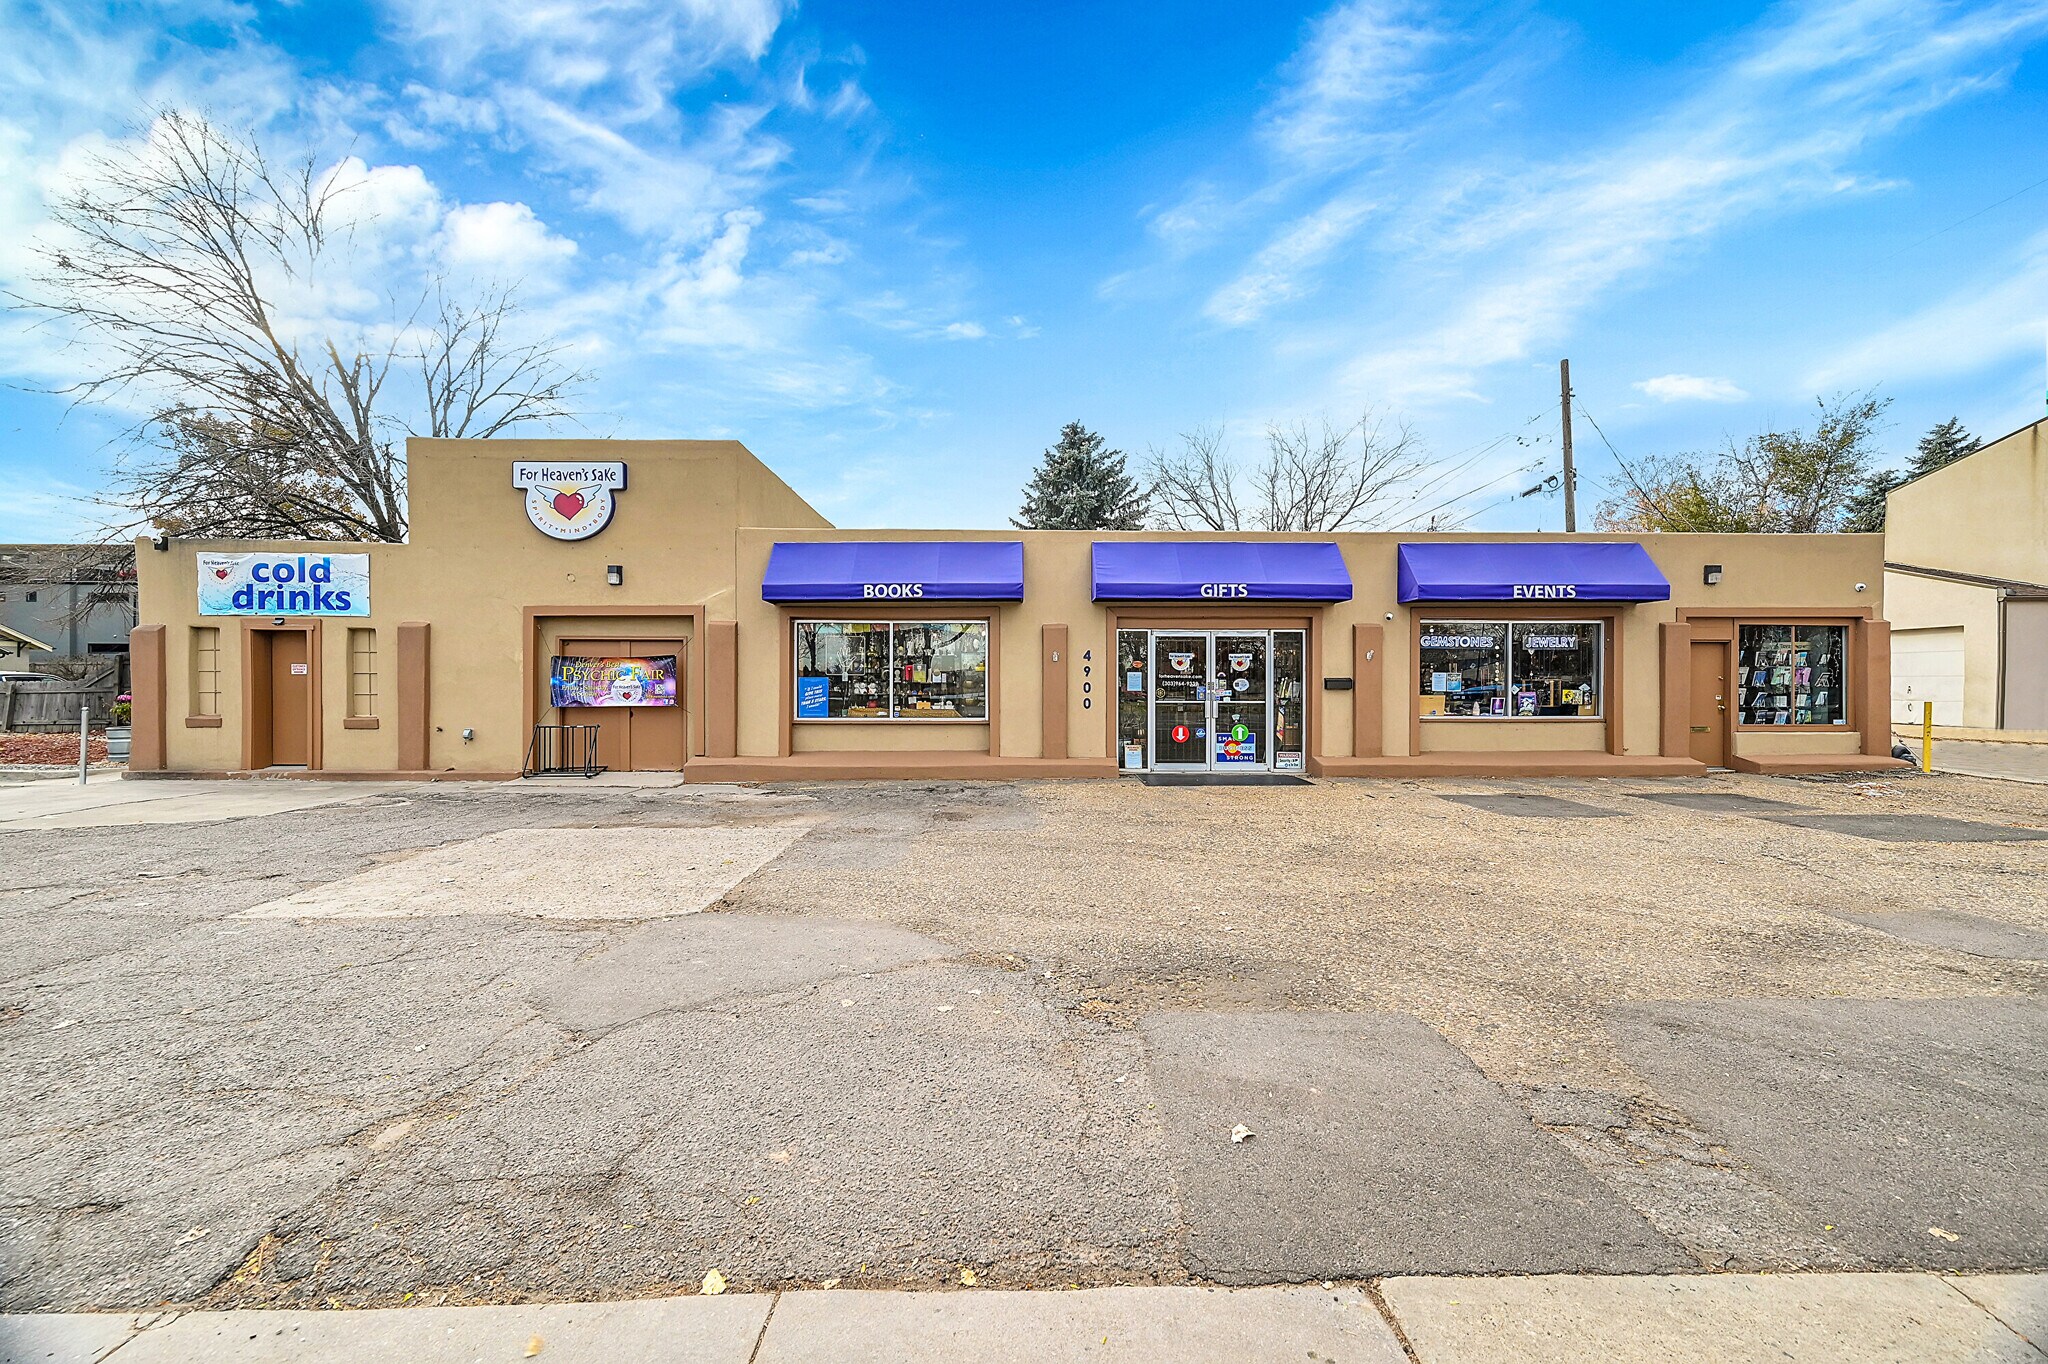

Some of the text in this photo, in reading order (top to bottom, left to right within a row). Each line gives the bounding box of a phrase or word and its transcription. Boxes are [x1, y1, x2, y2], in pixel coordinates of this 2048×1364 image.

[520, 468, 538, 481] For
[541, 468, 589, 481] Heaven's
[532, 499, 606, 534] SPIRIT MIND BODY
[251, 557, 331, 583] cold
[232, 584, 352, 611] drinks
[863, 583, 923, 598] BOOKS
[1200, 583, 1248, 598] GIFTS
[1513, 584, 1577, 599] EVENTS
[1420, 635, 1494, 648] GEMSTONES
[1526, 635, 1576, 648] JEWELRY
[1083, 650, 1091, 709] 4900
